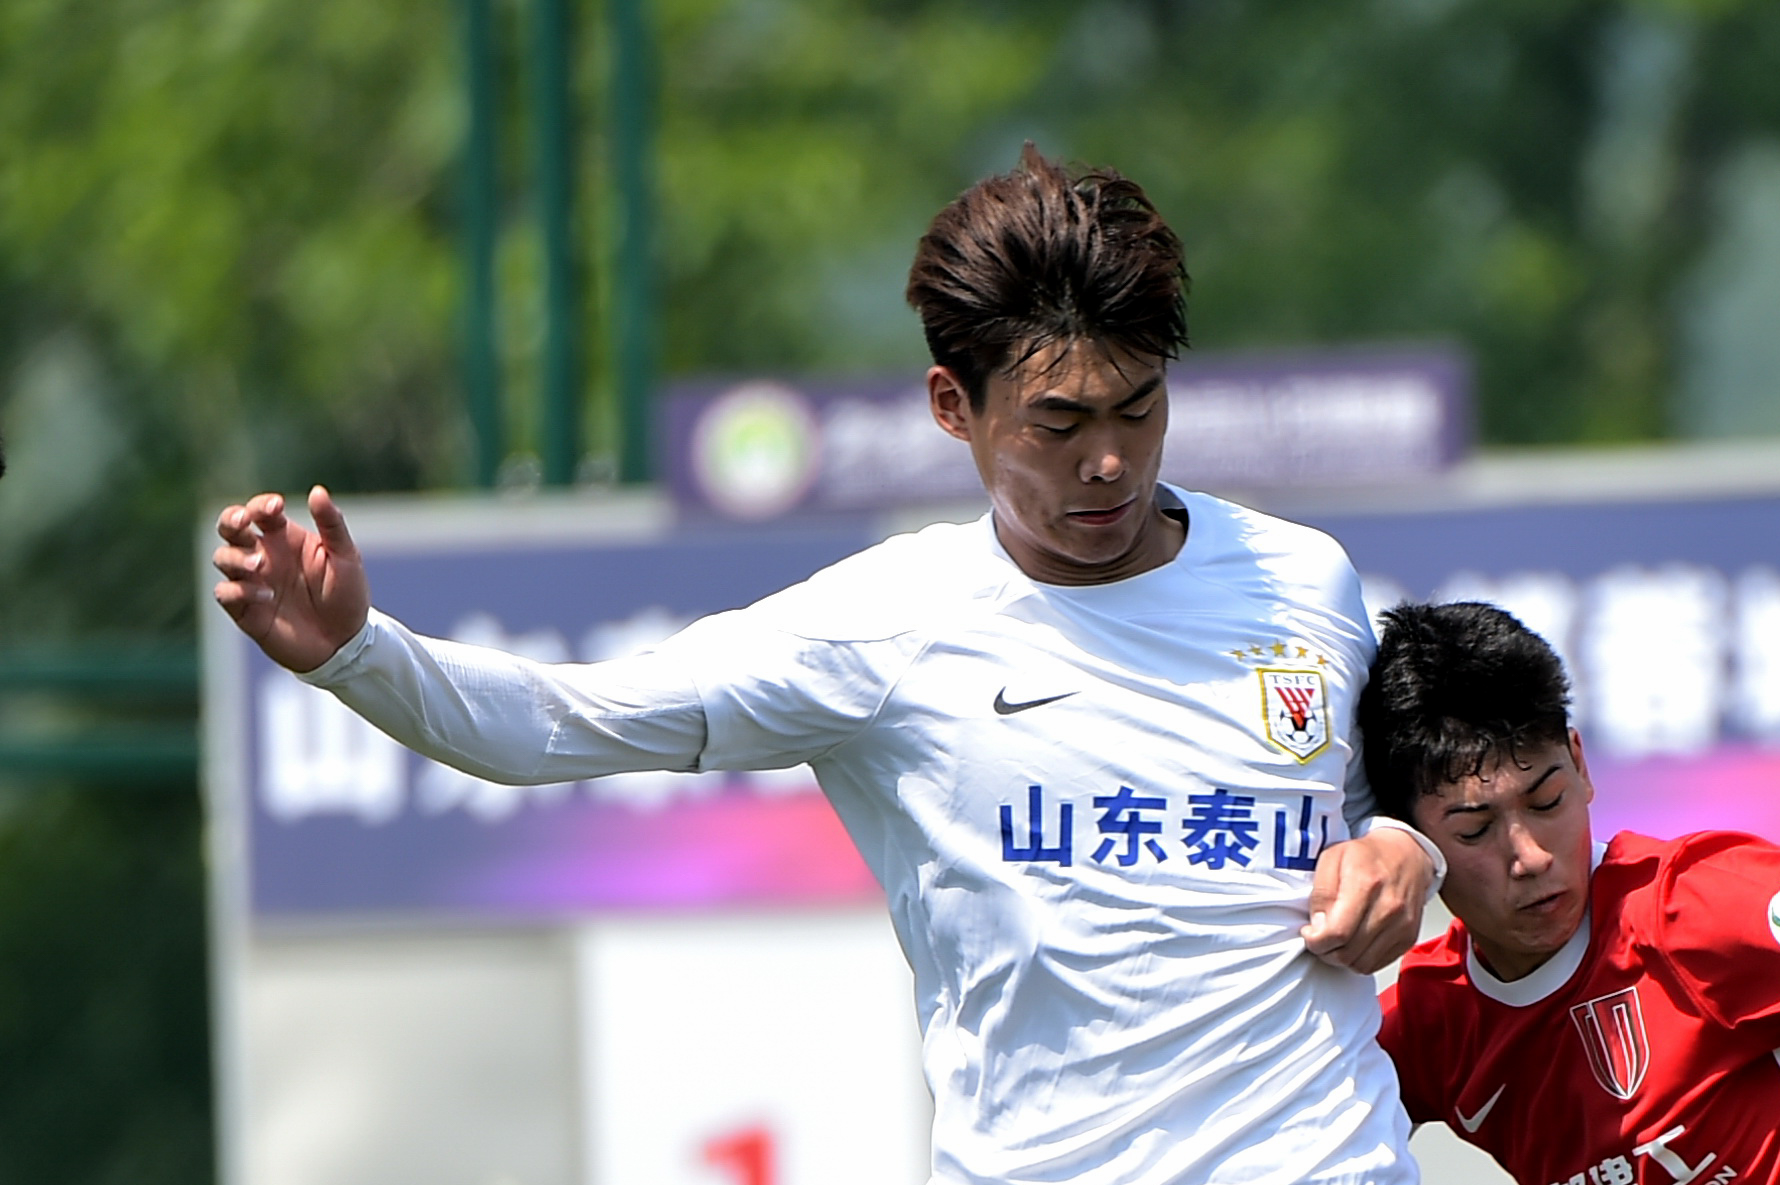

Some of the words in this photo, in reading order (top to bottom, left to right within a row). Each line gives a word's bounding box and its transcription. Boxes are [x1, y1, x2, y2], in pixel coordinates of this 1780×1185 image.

[1268, 673, 1317, 686] TSFC
[1000, 785, 1329, 871] 山东泰山
